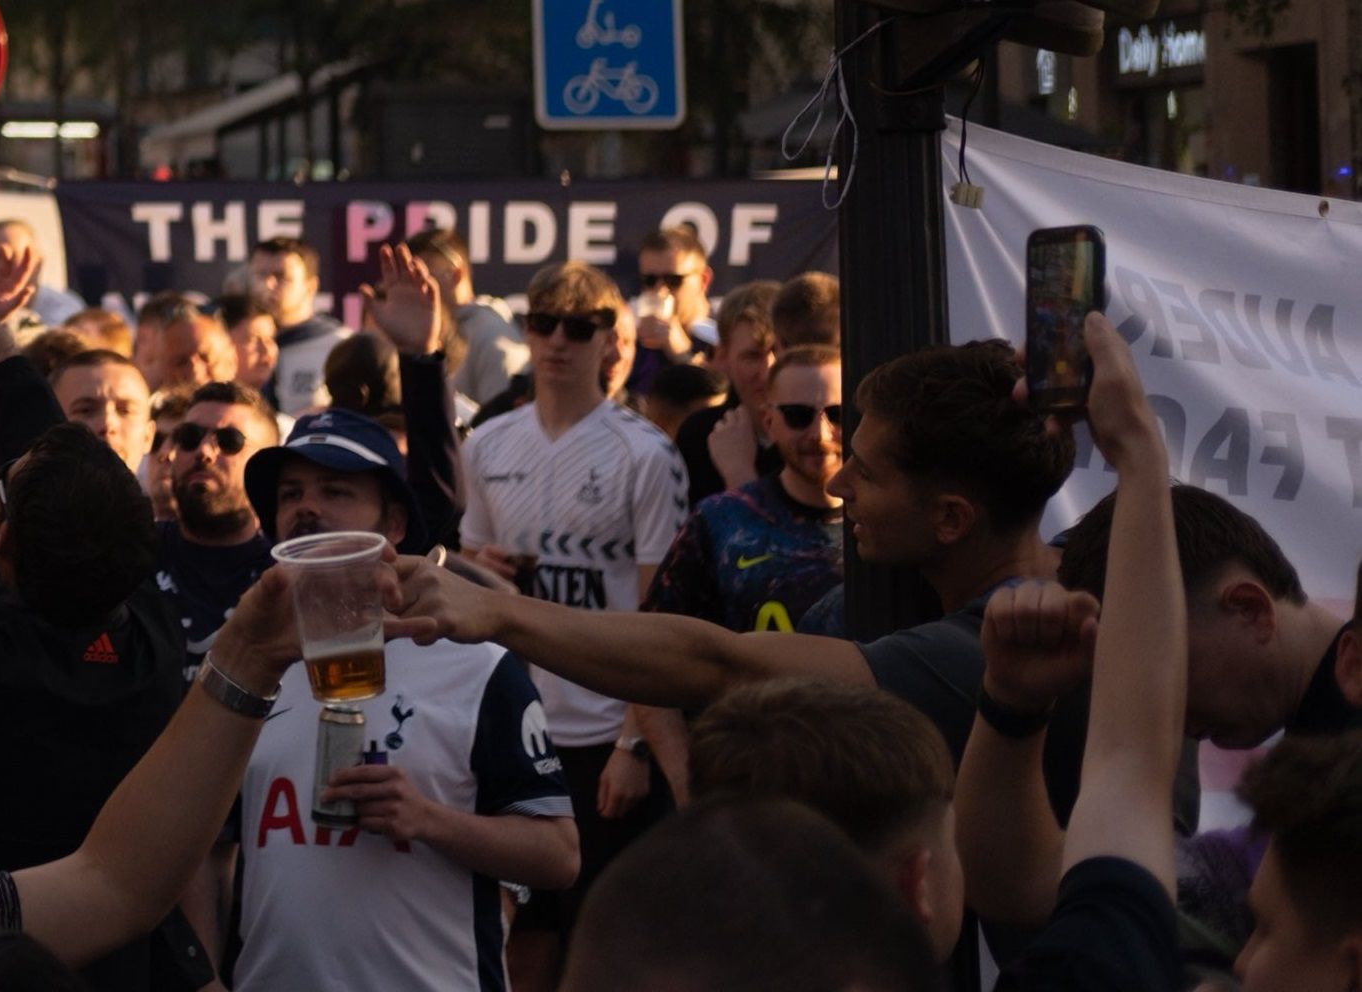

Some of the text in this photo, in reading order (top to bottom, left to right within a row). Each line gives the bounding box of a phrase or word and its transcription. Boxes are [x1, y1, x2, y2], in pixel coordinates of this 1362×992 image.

[130, 198, 780, 267] THE PRIDE OF
